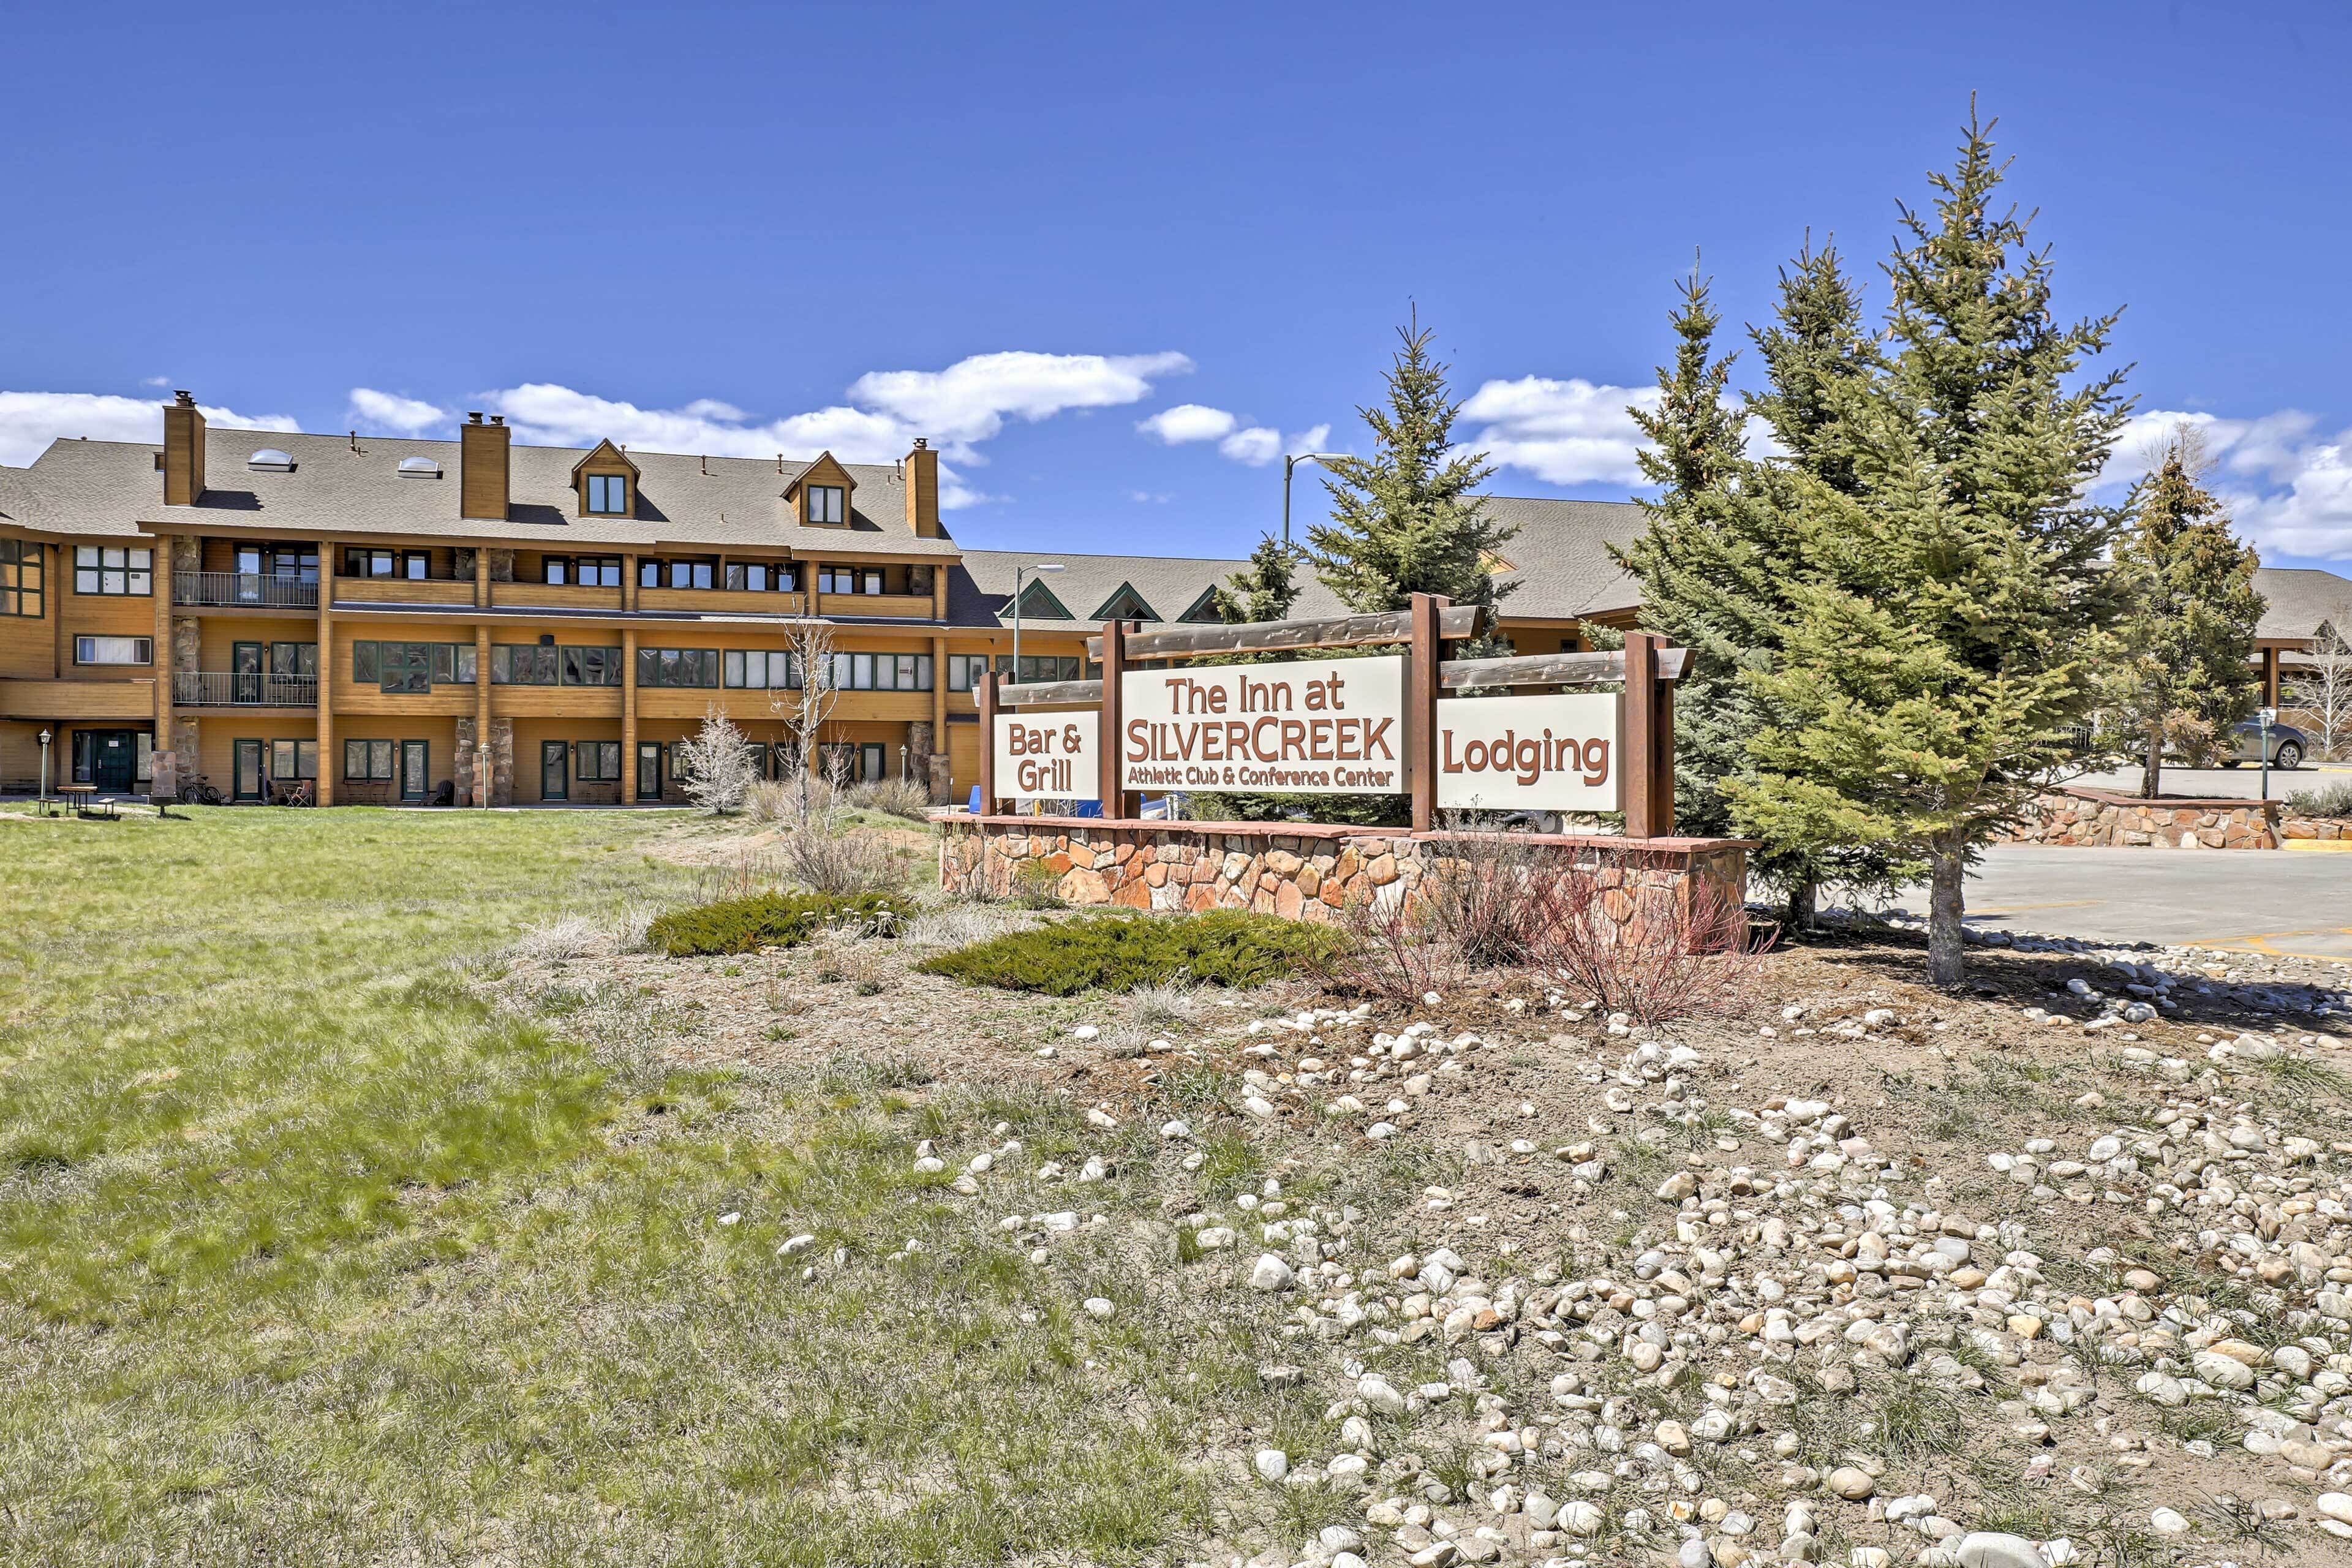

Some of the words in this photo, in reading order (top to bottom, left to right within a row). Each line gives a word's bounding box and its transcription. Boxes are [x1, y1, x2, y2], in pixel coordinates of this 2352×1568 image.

[1165, 678, 1227, 714] The
[1239, 675, 1293, 712] Inn
[1305, 671, 1344, 710] at
[1009, 724, 1057, 756] Bar
[1063, 724, 1081, 753] &
[1442, 728, 1610, 787] Lodging
[1018, 759, 1072, 792] Grill
[1128, 767, 1182, 785] Athletic
[1186, 767, 1218, 785] Club
[1223, 767, 1235, 785] &
[1239, 767, 1329, 786] Conference
[1334, 767, 1393, 786] Center
